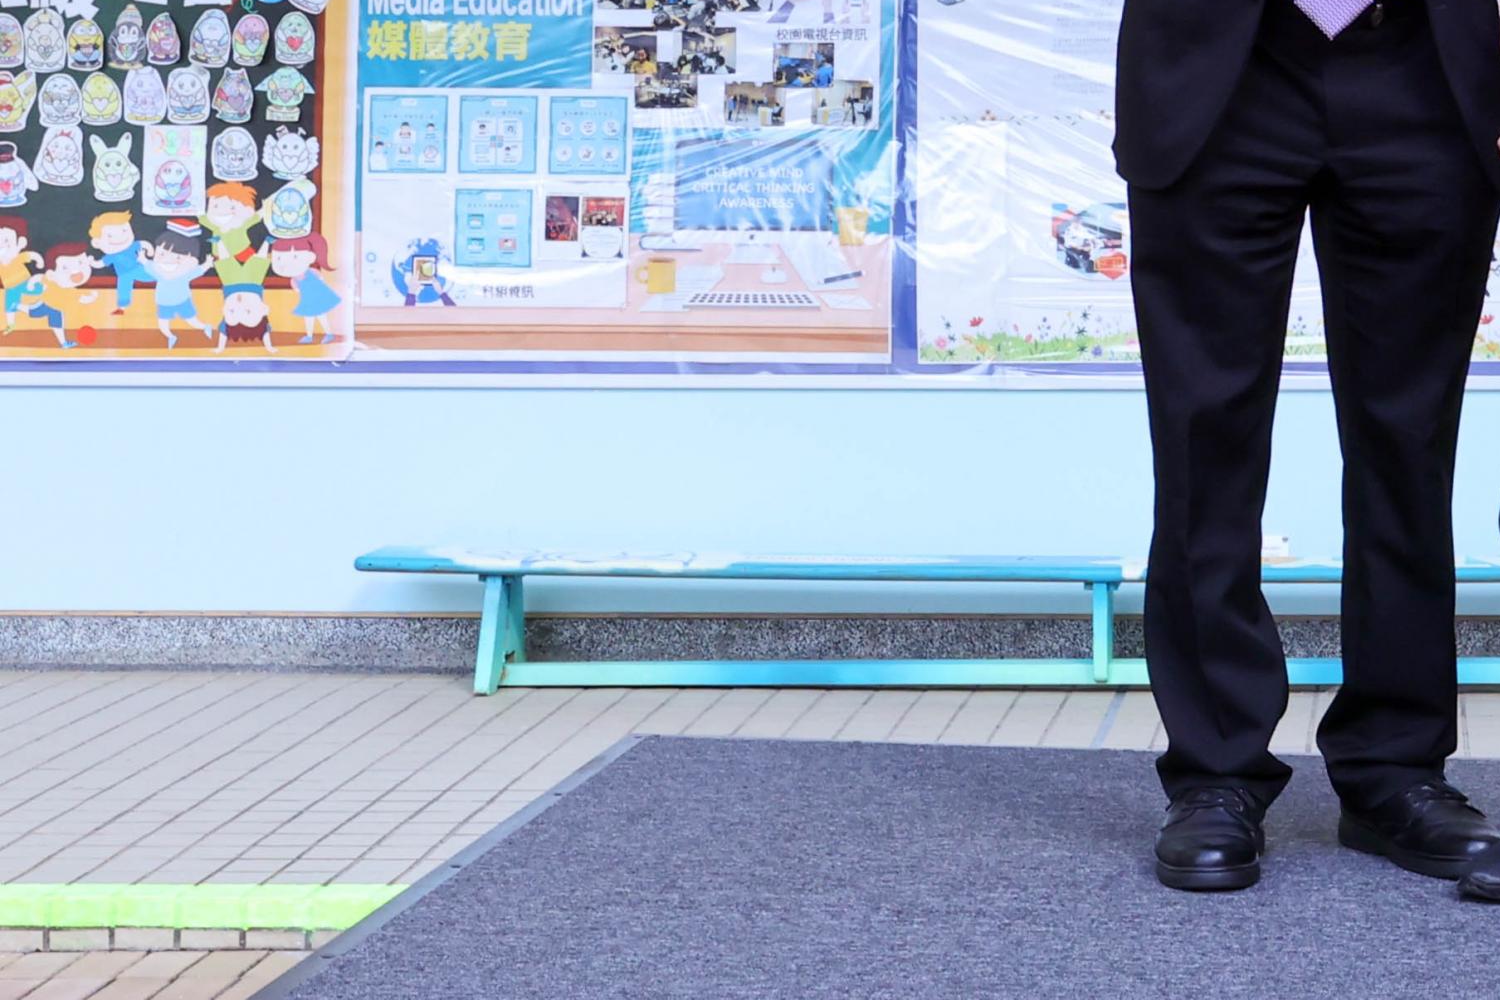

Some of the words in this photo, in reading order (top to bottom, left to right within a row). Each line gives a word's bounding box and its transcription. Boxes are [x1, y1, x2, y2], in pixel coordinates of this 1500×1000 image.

[366, 19, 533, 61] 媒體教育
[756, 182, 816, 193] THINKING
[718, 198, 795, 209] AWARENESS
